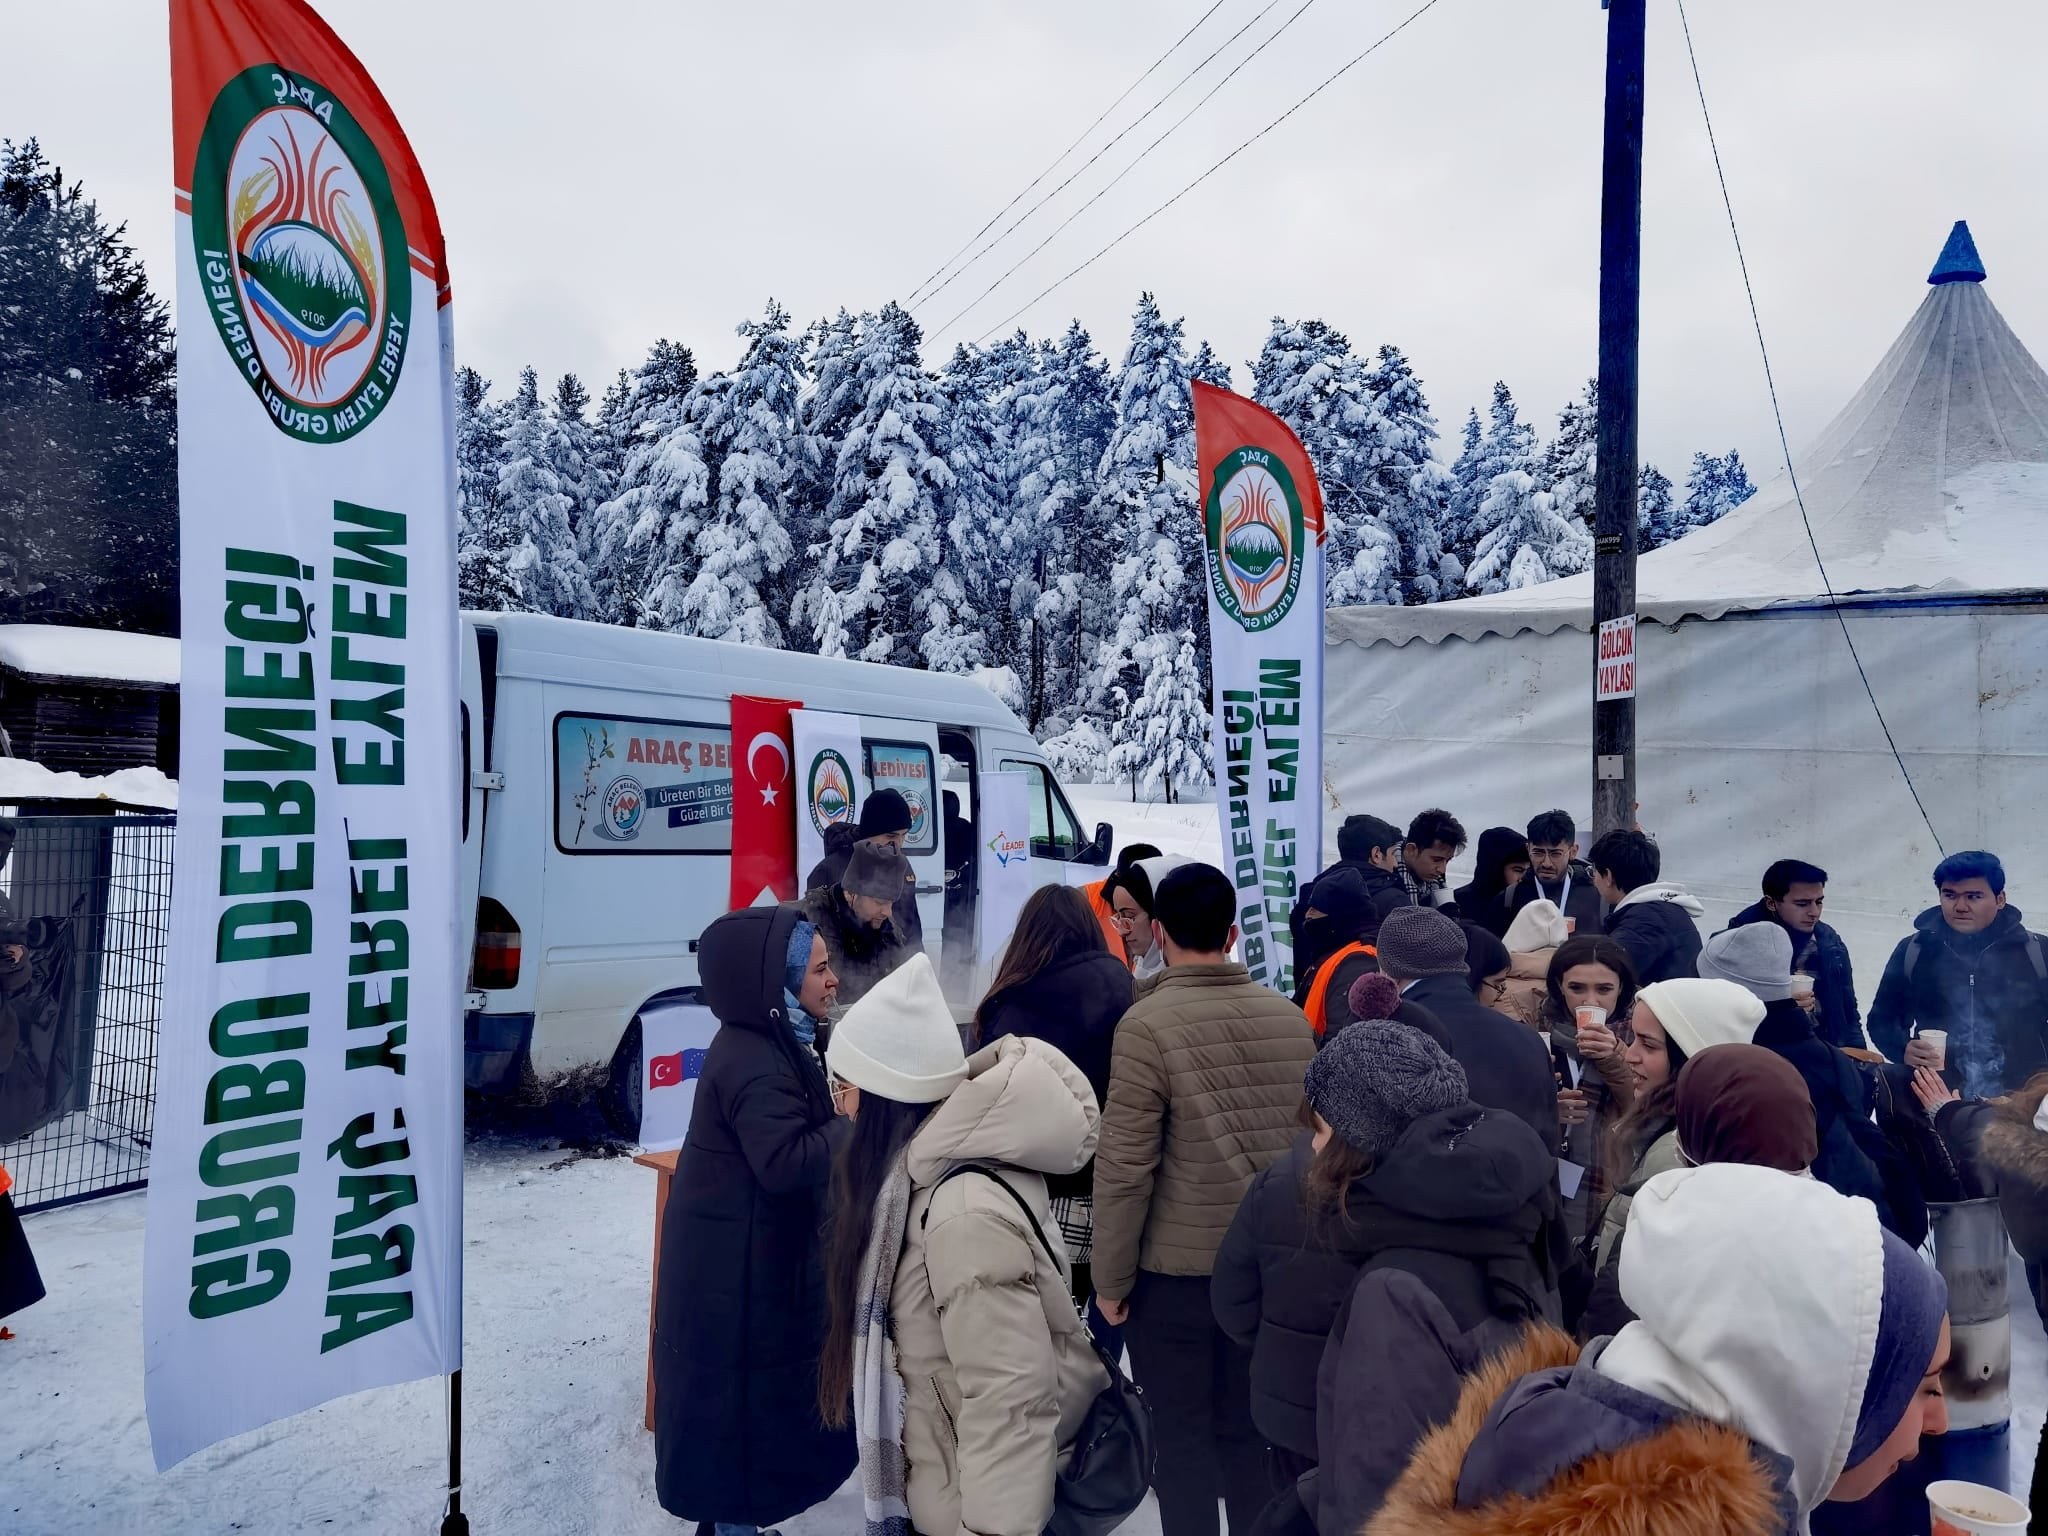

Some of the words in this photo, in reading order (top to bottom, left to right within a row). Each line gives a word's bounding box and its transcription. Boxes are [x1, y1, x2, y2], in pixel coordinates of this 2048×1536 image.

[1599, 662, 1633, 694] YAYLASI
[627, 737, 693, 773] ARAÇ
[660, 787, 695, 804] Üreten
[698, 785, 711, 798] Bir
[680, 806, 708, 822] Güzel
[711, 803, 724, 817] Bir
[1002, 841, 1024, 851] LEADER
